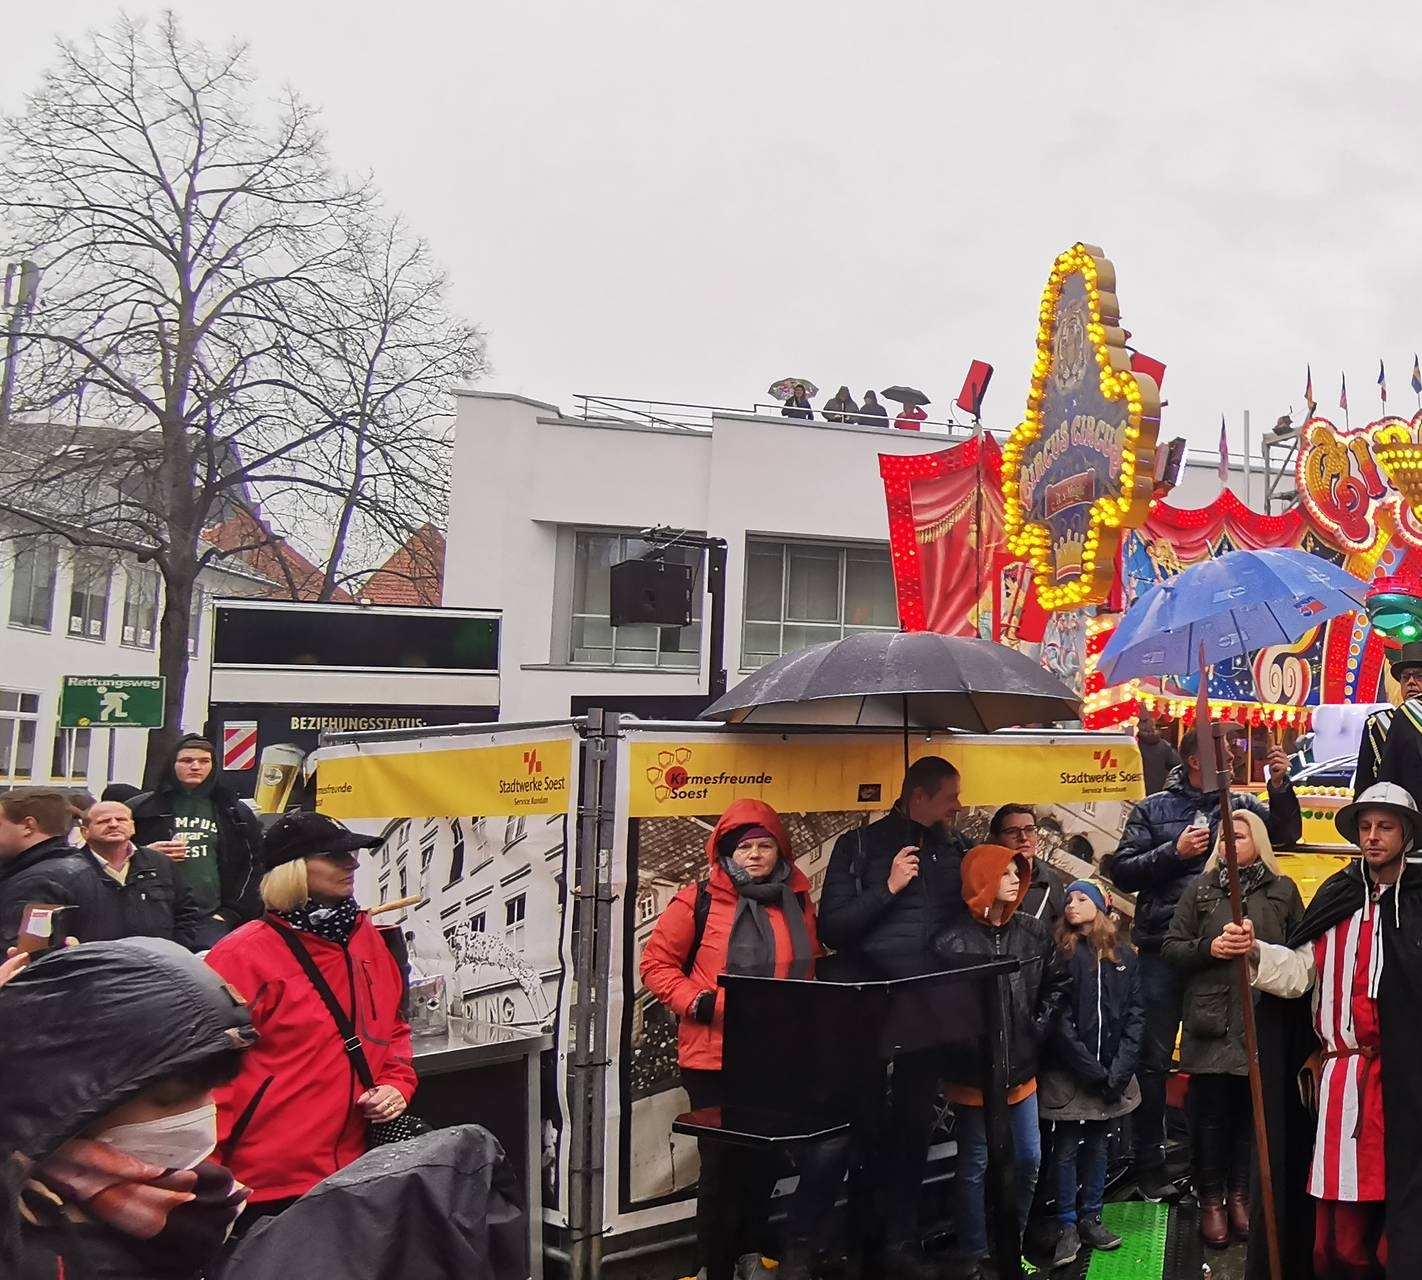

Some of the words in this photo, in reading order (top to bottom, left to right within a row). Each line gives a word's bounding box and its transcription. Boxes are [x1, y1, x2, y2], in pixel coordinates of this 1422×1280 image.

[1019, 419, 1070, 512] CIRCUS
[1070, 414, 1127, 480] CIRCUS
[67, 677, 160, 690] Rettungsweg
[670, 771, 773, 785] Kirmesfreunde
[1059, 771, 1117, 784] Stadtwerke
[499, 777, 543, 794] Stadtwerke
[543, 776, 566, 791] Soest
[670, 786, 709, 799] Soest
[175, 816, 218, 833] MPUS
[184, 844, 209, 858] EST
